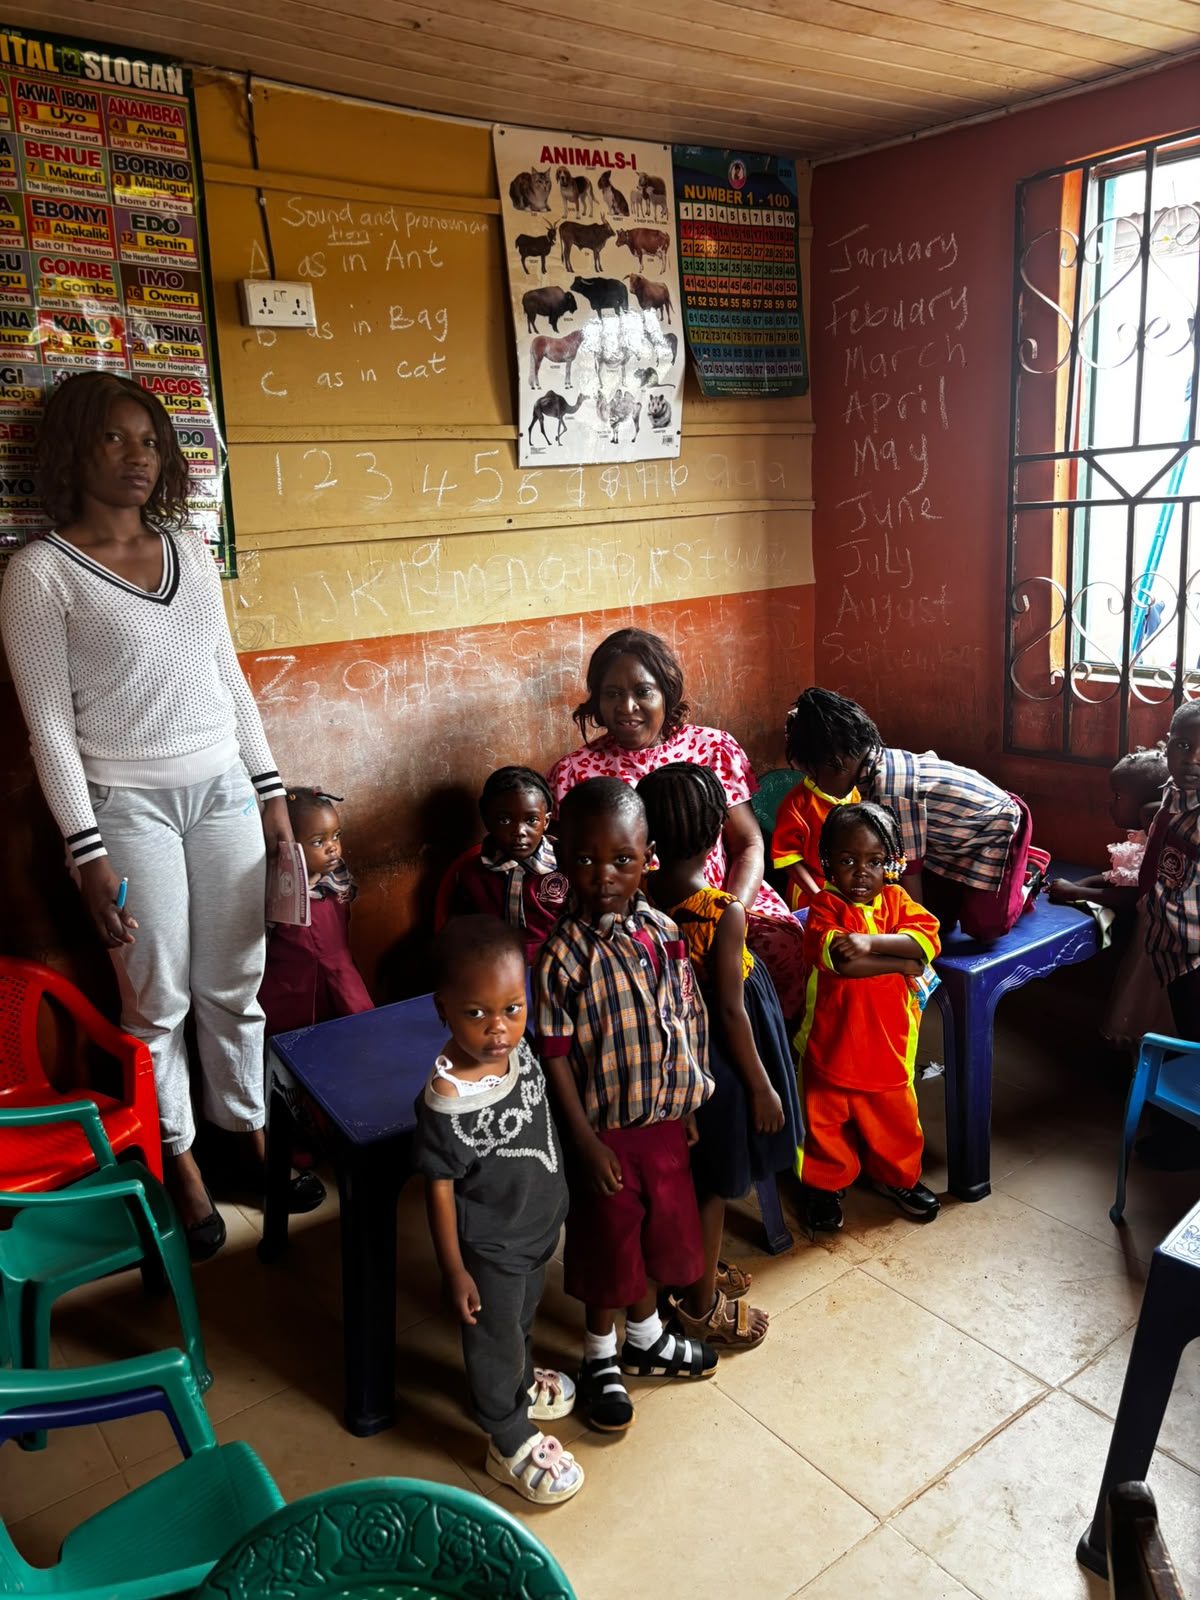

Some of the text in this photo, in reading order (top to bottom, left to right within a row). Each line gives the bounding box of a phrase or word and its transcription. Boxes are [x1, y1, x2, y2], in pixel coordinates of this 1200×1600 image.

[84, 51, 183, 95] SLOGAN
[17, 82, 97, 111] AKWA IBOM
[21, 104, 86, 124] 3 Uyo
[108, 98, 183, 126] ANAMBRA
[24, 124, 98, 143] Promised Land
[112, 120, 177, 140] 4 Awka
[24, 140, 102, 168] BENUE
[113, 138, 185, 156] Light Of The Nation
[540, 145, 637, 170] ANIMALS-I
[29, 162, 102, 184] 7 Makurdi
[113, 154, 188, 179] BORNO
[28, 181, 40, 189] The
[41, 183, 68, 193] Nigeria's
[70, 187, 85, 196] Food
[115, 175, 190, 195] 8 Maiduguri
[120, 196, 187, 212] Home Of Peace
[683, 184, 743, 205] NUMBER
[747, 191, 754, 206] 1
[767, 193, 790, 208] 100
[32, 199, 107, 225] EBONYI
[281, 197, 354, 227] Sound
[359, 206, 399, 231] and
[35, 221, 109, 241] 11 Abakaliki
[131, 214, 180, 235] EDO
[35, 241, 51, 249] Salt
[67, 244, 82, 253] The
[84, 246, 112, 257] Nation
[121, 233, 187, 250] 12 Benin
[828, 224, 958, 272] January
[39, 257, 113, 280] GOMBE
[249, 240, 444, 278] A as in Ant
[41, 277, 114, 295] 15 Gombe
[138, 268, 184, 289] IMO
[686, 279, 761, 291] 41 42 43 44 45 46 47
[40, 298, 61, 307] Jewel
[129, 287, 195, 304] 16 Owerri
[687, 295, 797, 309] 51 52 53 54 55 56 57 58 59 60
[129, 306, 200, 320] The Eastern Heartland
[825, 285, 968, 337] Febuary
[54, 315, 110, 335] KANO
[131, 322, 202, 343] KATSINA
[306, 321, 334, 340] as
[352, 312, 371, 335] in
[389, 305, 448, 342] Bag
[71, 336, 113, 350] Kano
[134, 343, 200, 357] 20 Katsina
[135, 361, 155, 369] Home
[157, 362, 166, 370] Of
[845, 332, 968, 387] March
[141, 377, 203, 396] LAGOS
[317, 371, 344, 388] as
[359, 364, 376, 381] in
[164, 395, 201, 409] Ikeja
[176, 415, 211, 425] Excellence
[853, 433, 929, 496] May
[275, 451, 283, 496] 1
[303, 447, 338, 490] 2
[355, 451, 393, 501] 3
[422, 463, 458, 507] 4
[474, 449, 504, 503] 5
[517, 471, 543, 505] 6
[835, 490, 944, 533] June
[835, 582, 951, 634] August
